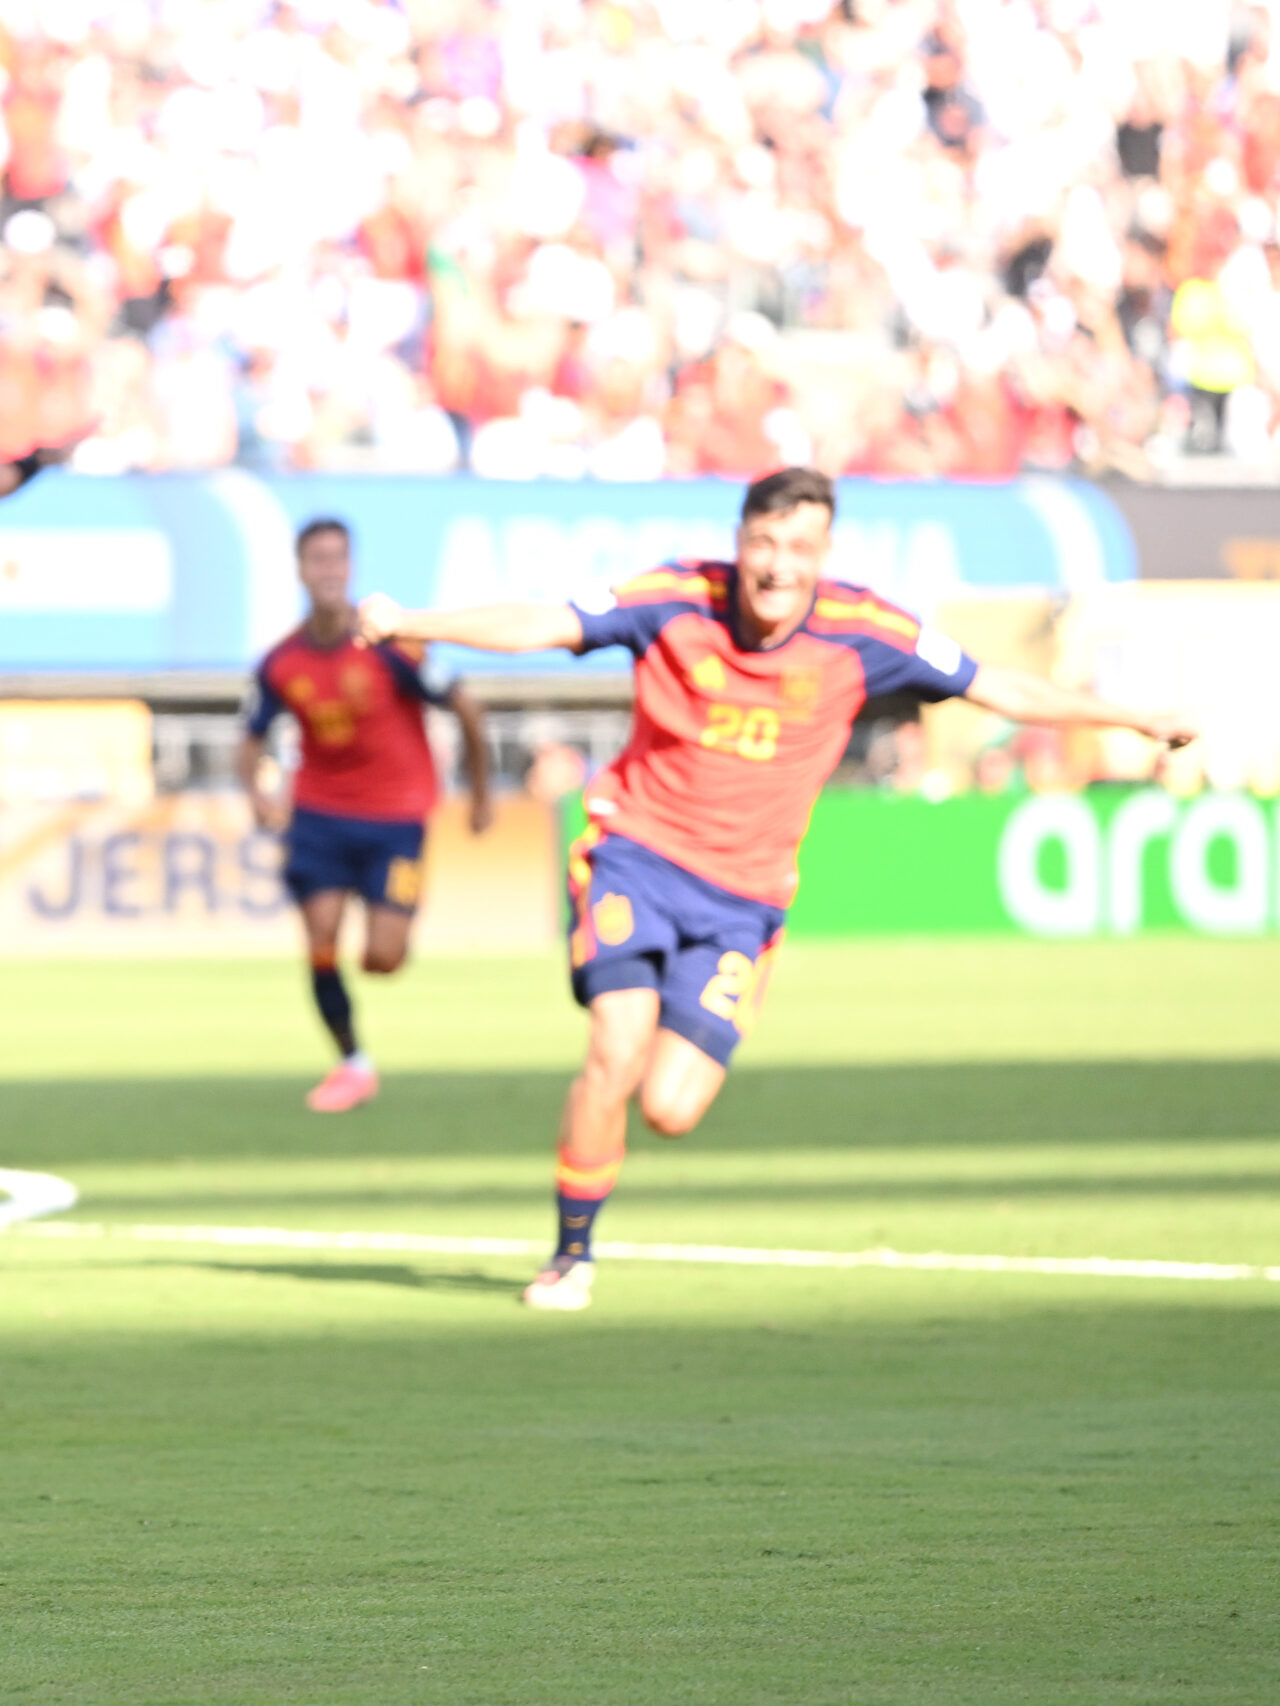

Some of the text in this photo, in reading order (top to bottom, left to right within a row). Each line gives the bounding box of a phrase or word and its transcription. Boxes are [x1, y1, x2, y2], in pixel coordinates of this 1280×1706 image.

[432, 518, 963, 606] ARGNA
[701, 703, 779, 760] 20
[26, 833, 286, 917] JERS
[997, 790, 1280, 935] ara
